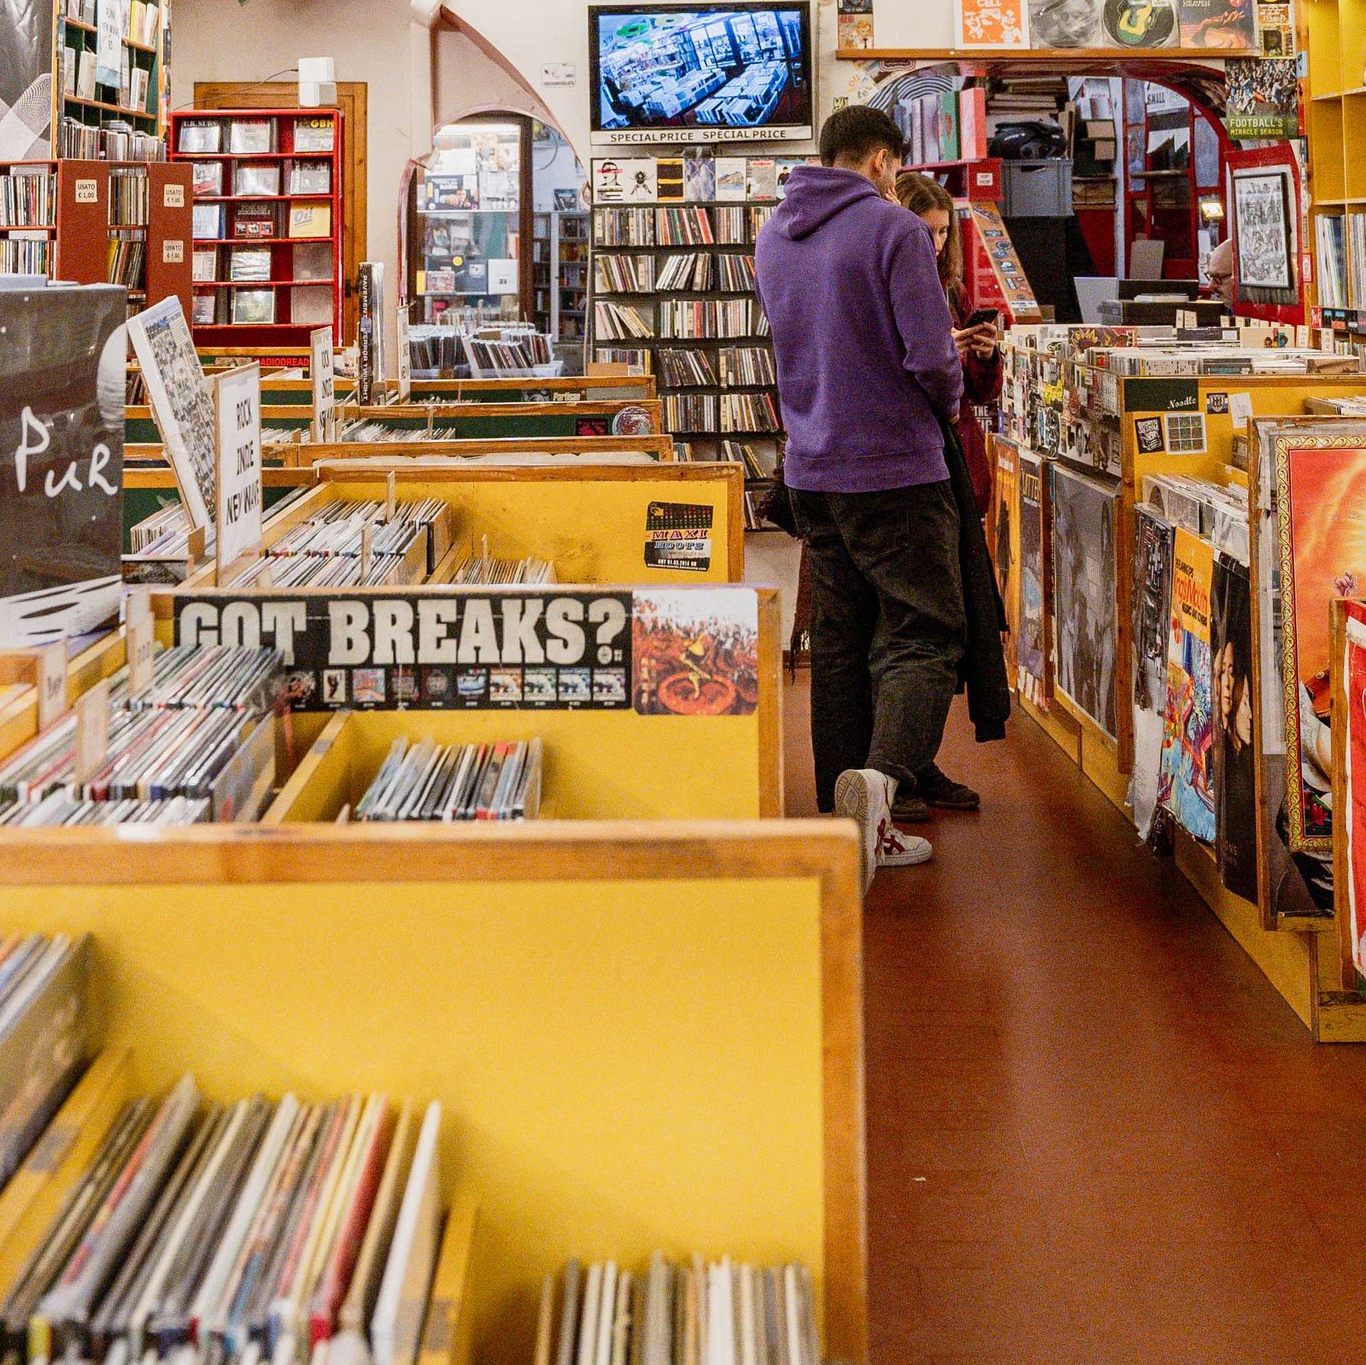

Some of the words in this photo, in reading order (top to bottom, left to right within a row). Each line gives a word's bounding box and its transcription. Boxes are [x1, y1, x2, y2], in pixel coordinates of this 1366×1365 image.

[1229, 117, 1283, 127] FOOTBALL'S
[610, 133, 658, 143] SPECIAL
[659, 132, 693, 141] PRICE
[702, 129, 750, 140] SPECIAL
[752, 129, 786, 139] PRICE
[77, 183, 96, 191] USATO
[294, 207, 313, 223] Oi!
[165, 244, 183, 252] USATO
[1166, 397, 1197, 410] Noodle
[236, 396, 253, 429] ROCK
[236, 441, 254, 477] INDIE
[226, 489, 244, 526] NEW
[651, 528, 708, 540] MAXI
[179, 600, 307, 666] GOT
[327, 597, 626, 665] BREAKS?
